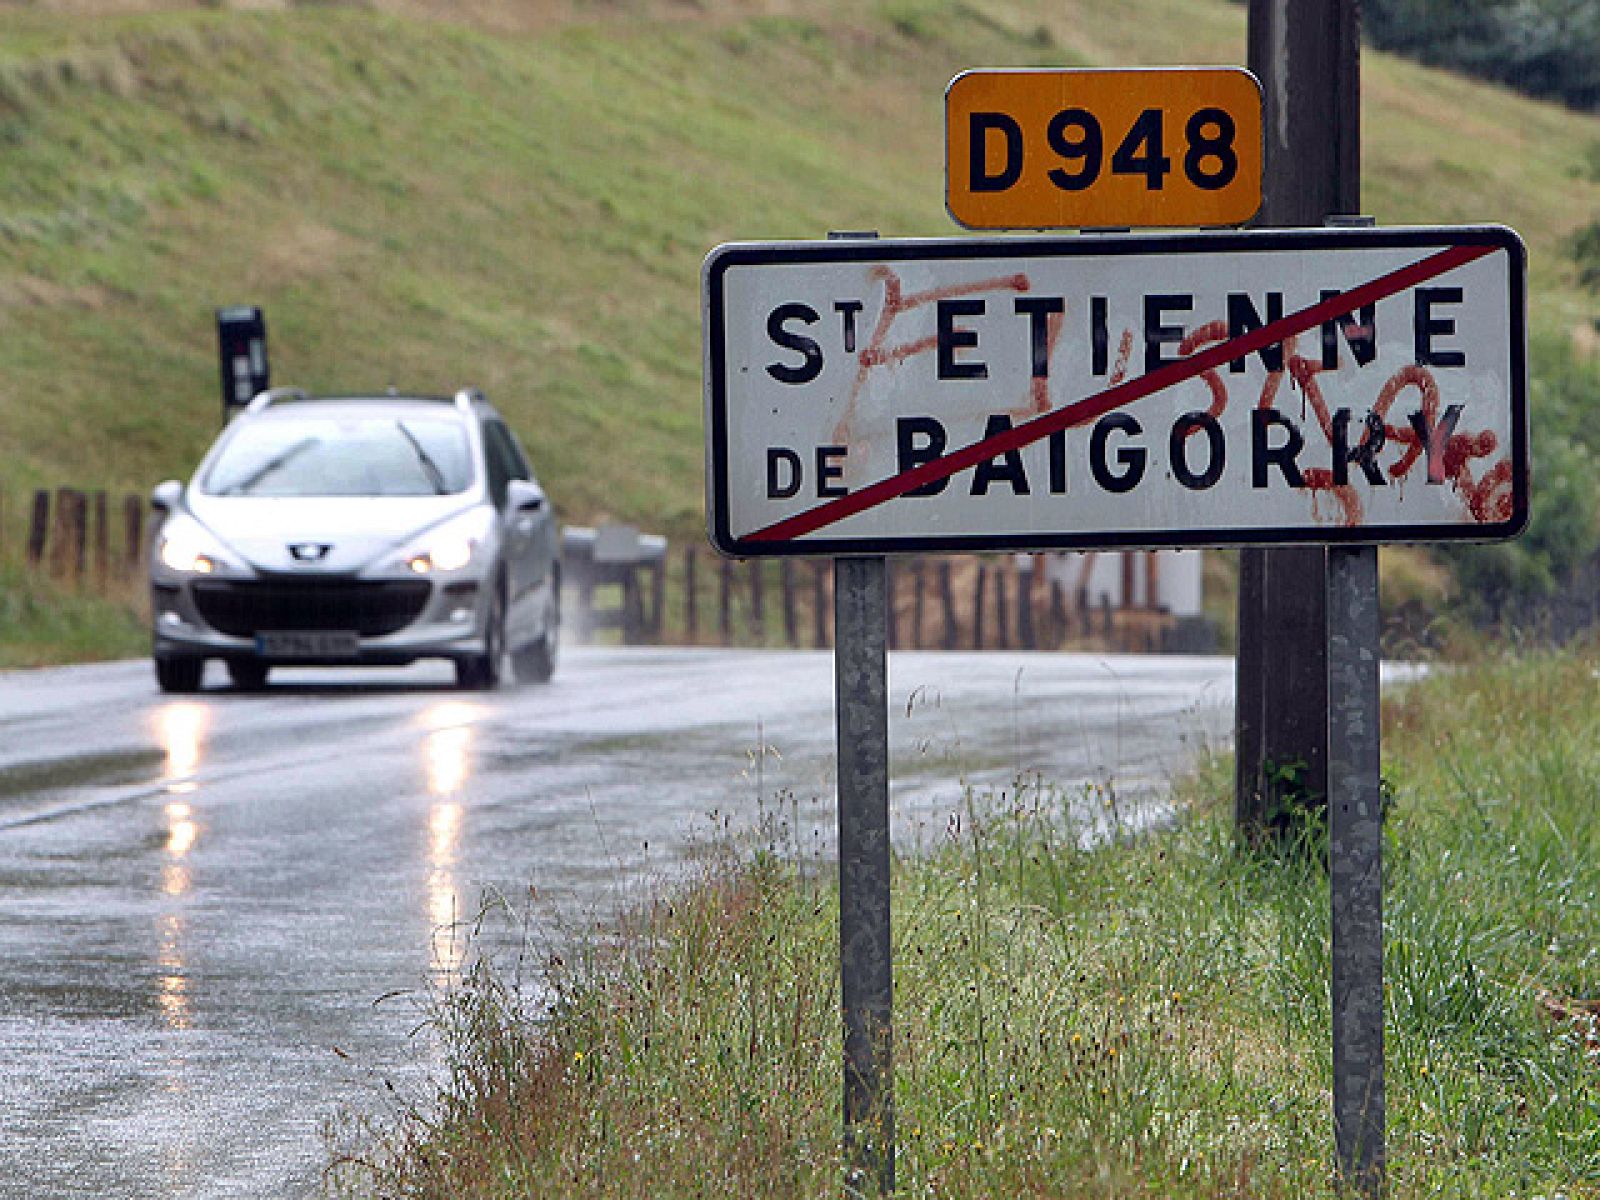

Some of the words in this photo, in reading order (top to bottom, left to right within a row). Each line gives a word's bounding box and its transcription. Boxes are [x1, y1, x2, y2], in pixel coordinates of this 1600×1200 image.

[936, 287, 1466, 381] ETIENNE
[766, 446, 849, 500] DE
[896, 404, 1466, 498] BAIGORRY
